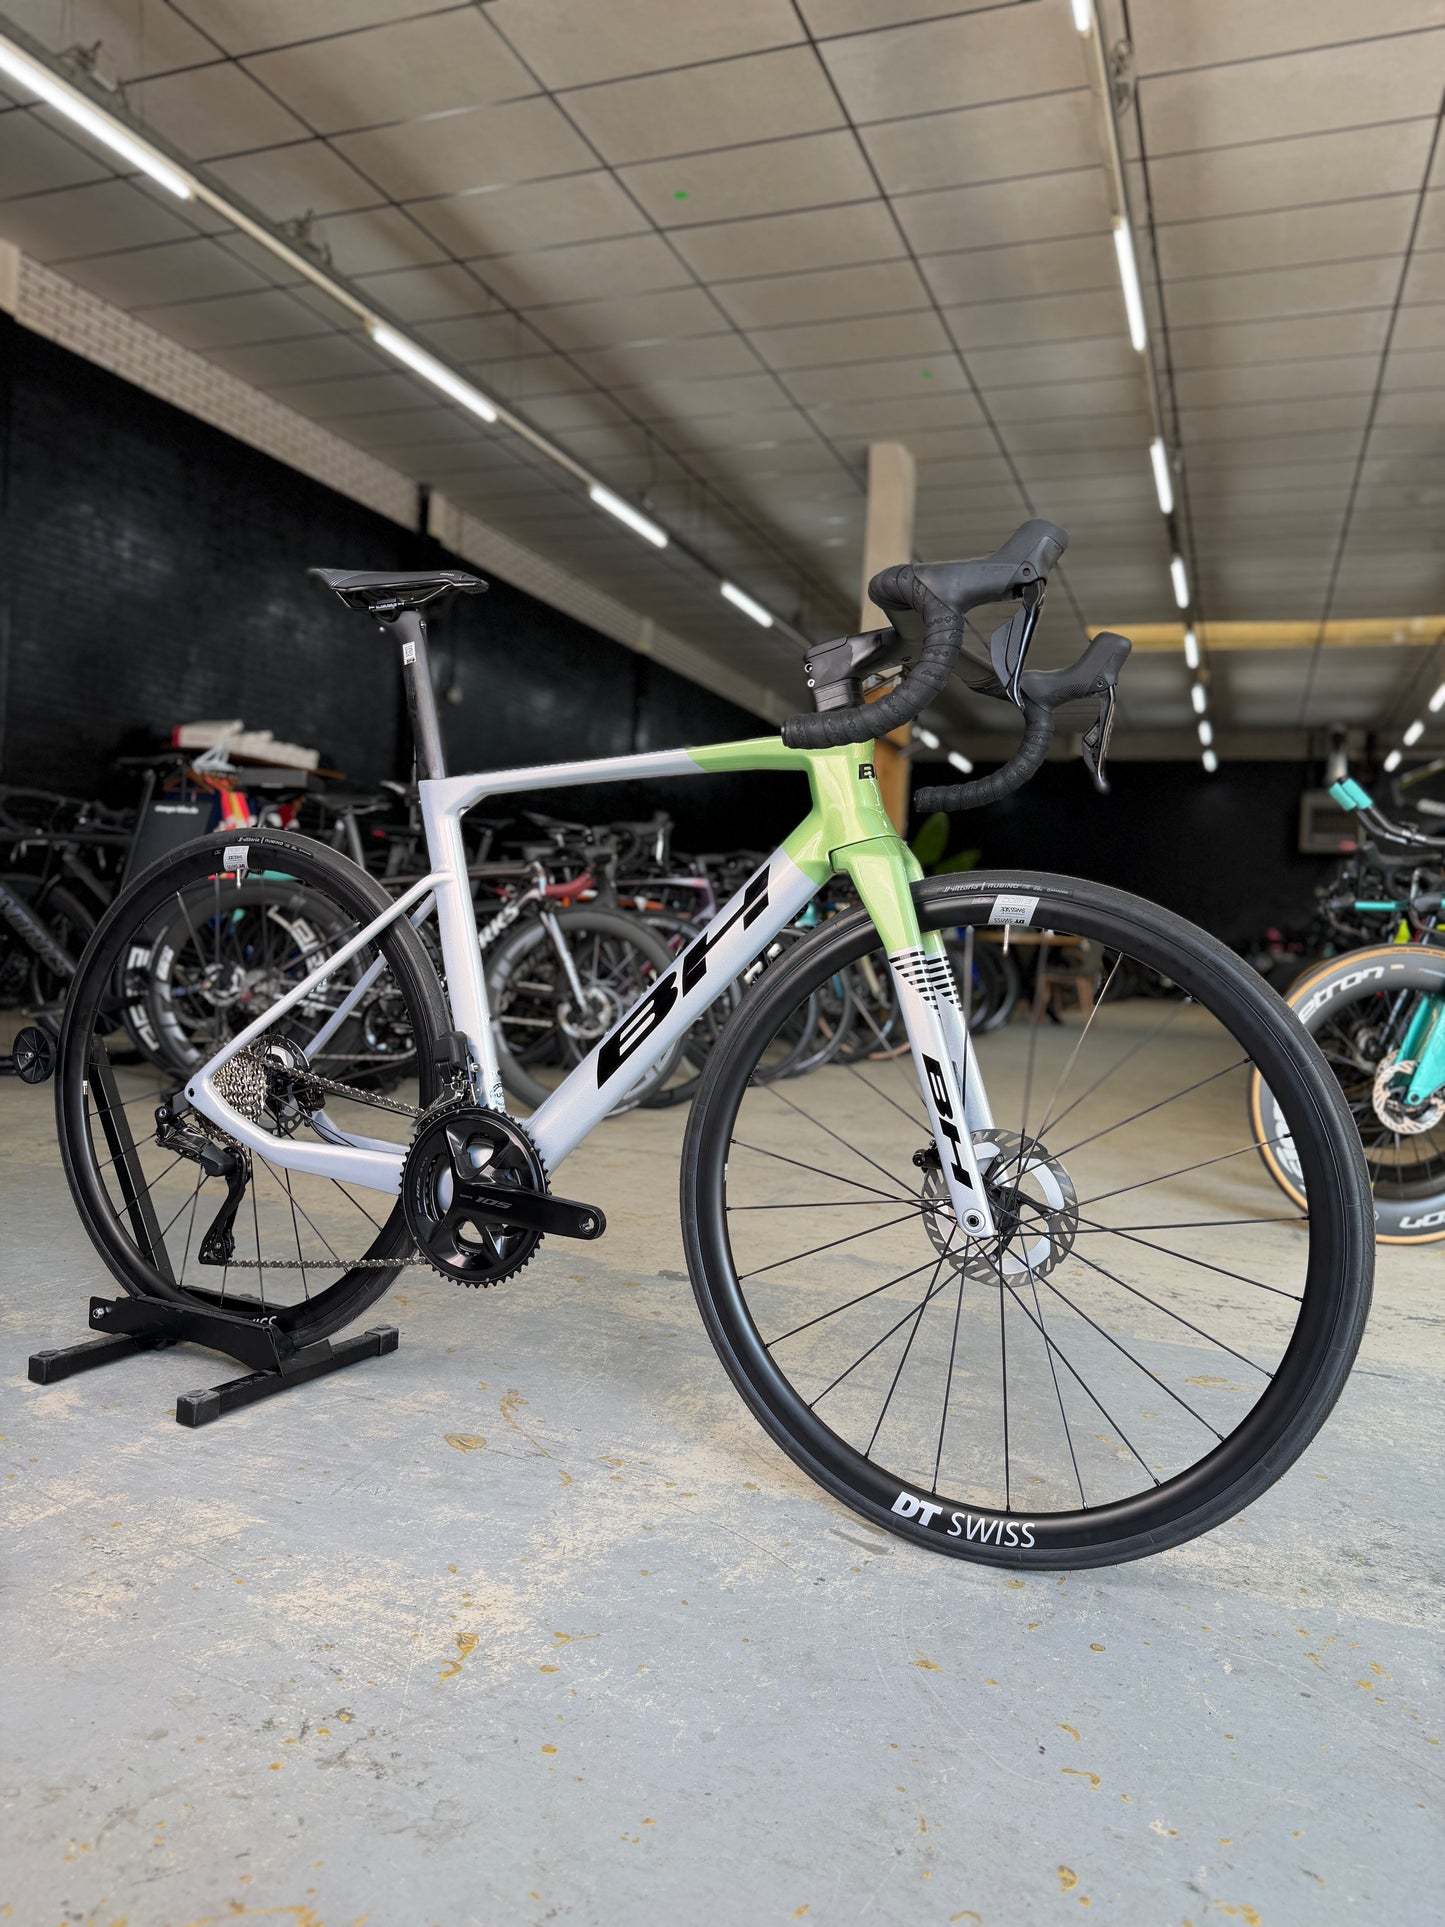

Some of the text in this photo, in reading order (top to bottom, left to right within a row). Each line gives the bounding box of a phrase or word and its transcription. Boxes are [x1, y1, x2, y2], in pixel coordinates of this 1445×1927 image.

[858, 763, 877, 780] B
[950, 882, 979, 892] vittoria
[479, 904, 520, 949] RKS
[596, 864, 771, 1090] BH
[1298, 966, 1385, 1025] etron
[921, 1052, 974, 1191] BH
[474, 1196, 513, 1209] 105
[890, 1491, 1036, 1549] DT SWISS
